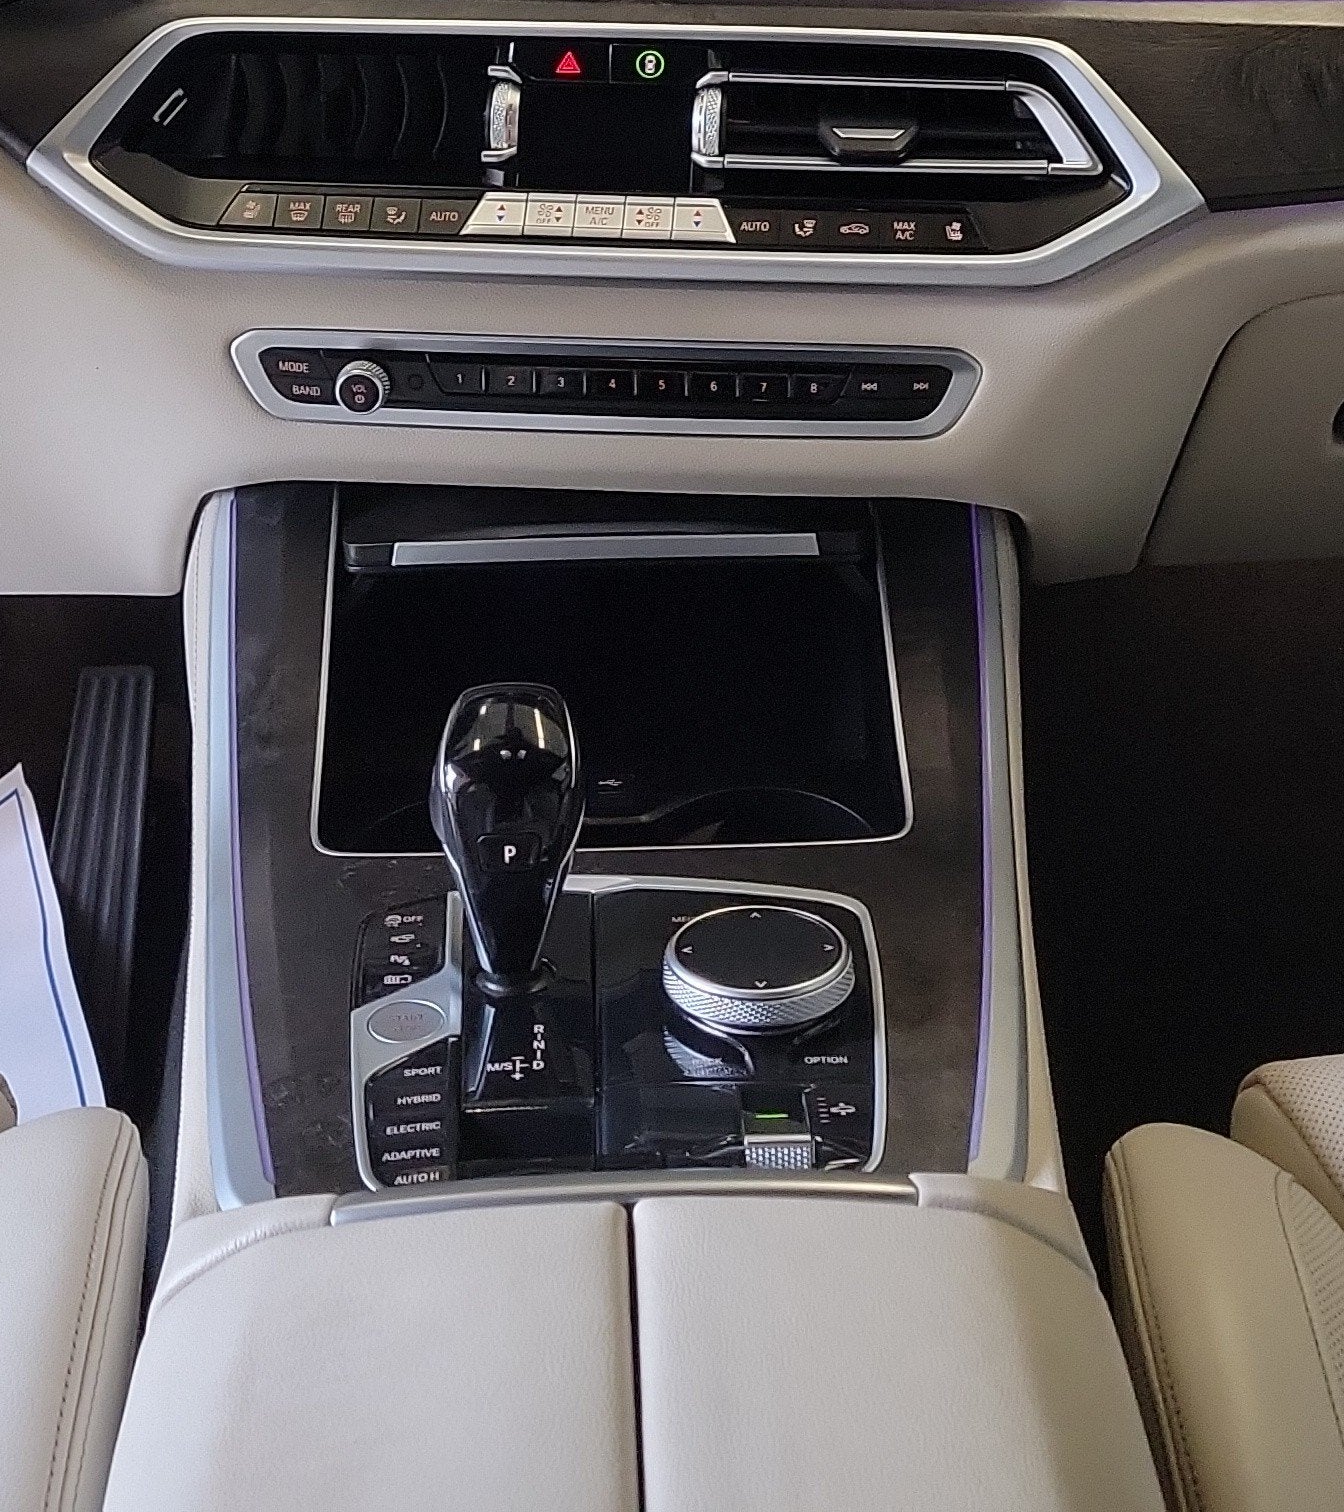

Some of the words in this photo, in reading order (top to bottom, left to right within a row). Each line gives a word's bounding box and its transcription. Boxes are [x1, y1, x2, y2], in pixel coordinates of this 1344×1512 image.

[289, 201, 312, 212] MAX
[335, 203, 361, 215] REAR
[585, 206, 615, 216] MENU
[429, 210, 459, 222] AUTO
[589, 217, 609, 226] A/C
[739, 220, 770, 233] AUTO
[893, 221, 916, 231] MAX
[895, 230, 916, 241] A/C
[278, 361, 310, 374] MODE
[292, 384, 321, 397] BAND
[503, 845, 517, 863] P
[533, 1024, 545, 1034] R
[532, 1039, 546, 1050] N
[532, 1060, 545, 1070] D
[804, 1055, 849, 1065] OPTION
[403, 1066, 443, 1077] SPORT
[396, 1093, 442, 1106] HYBRID
[385, 1121, 441, 1135] ELECTRIC
[382, 1148, 441, 1162] ADAPTIVE
[394, 1173, 429, 1185] AUTO
[429, 1171, 440, 1182] H
